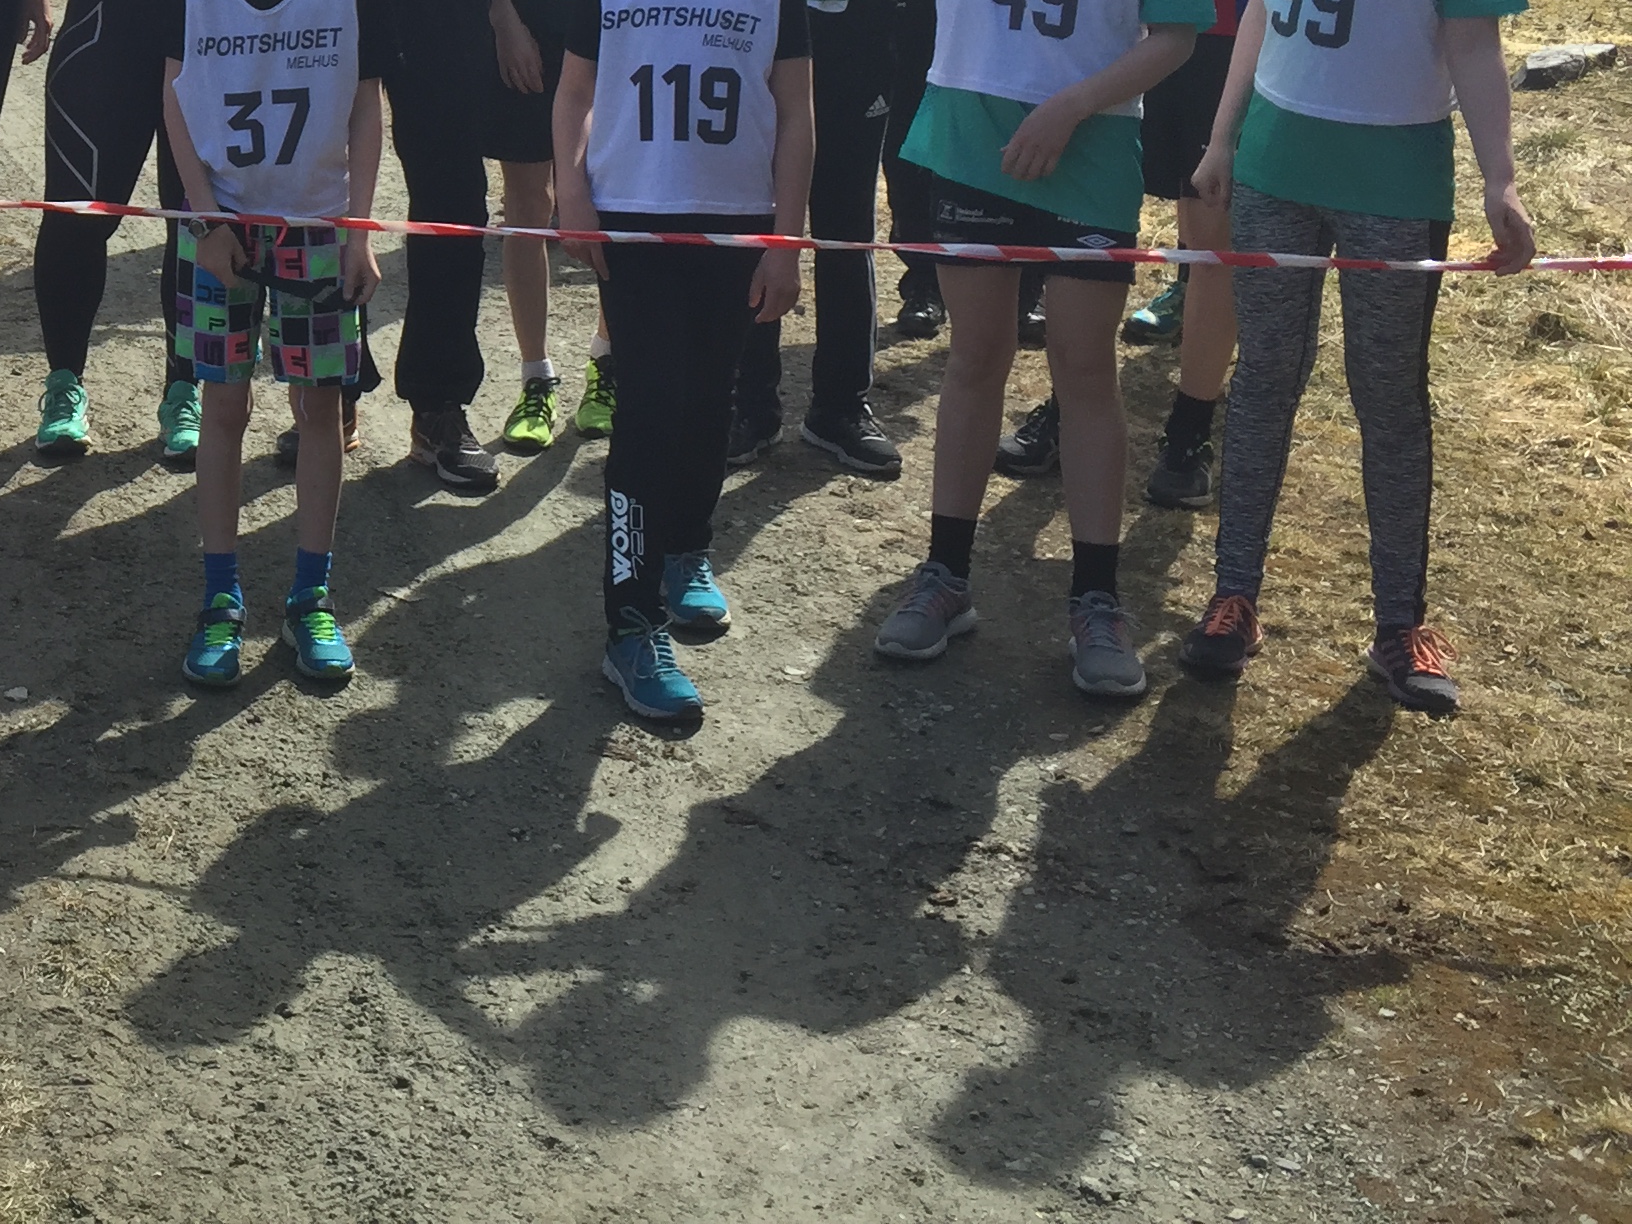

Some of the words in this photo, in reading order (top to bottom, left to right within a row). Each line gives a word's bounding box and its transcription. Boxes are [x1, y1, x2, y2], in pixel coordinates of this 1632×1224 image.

[602, 6, 761, 35] SPORTSHUSET
[197, 27, 342, 56] SPORTSHUSET
[702, 33, 754, 54] MELHUS
[286, 54, 339, 69] MELHUS
[629, 64, 742, 145] 119
[224, 87, 311, 168] 37
